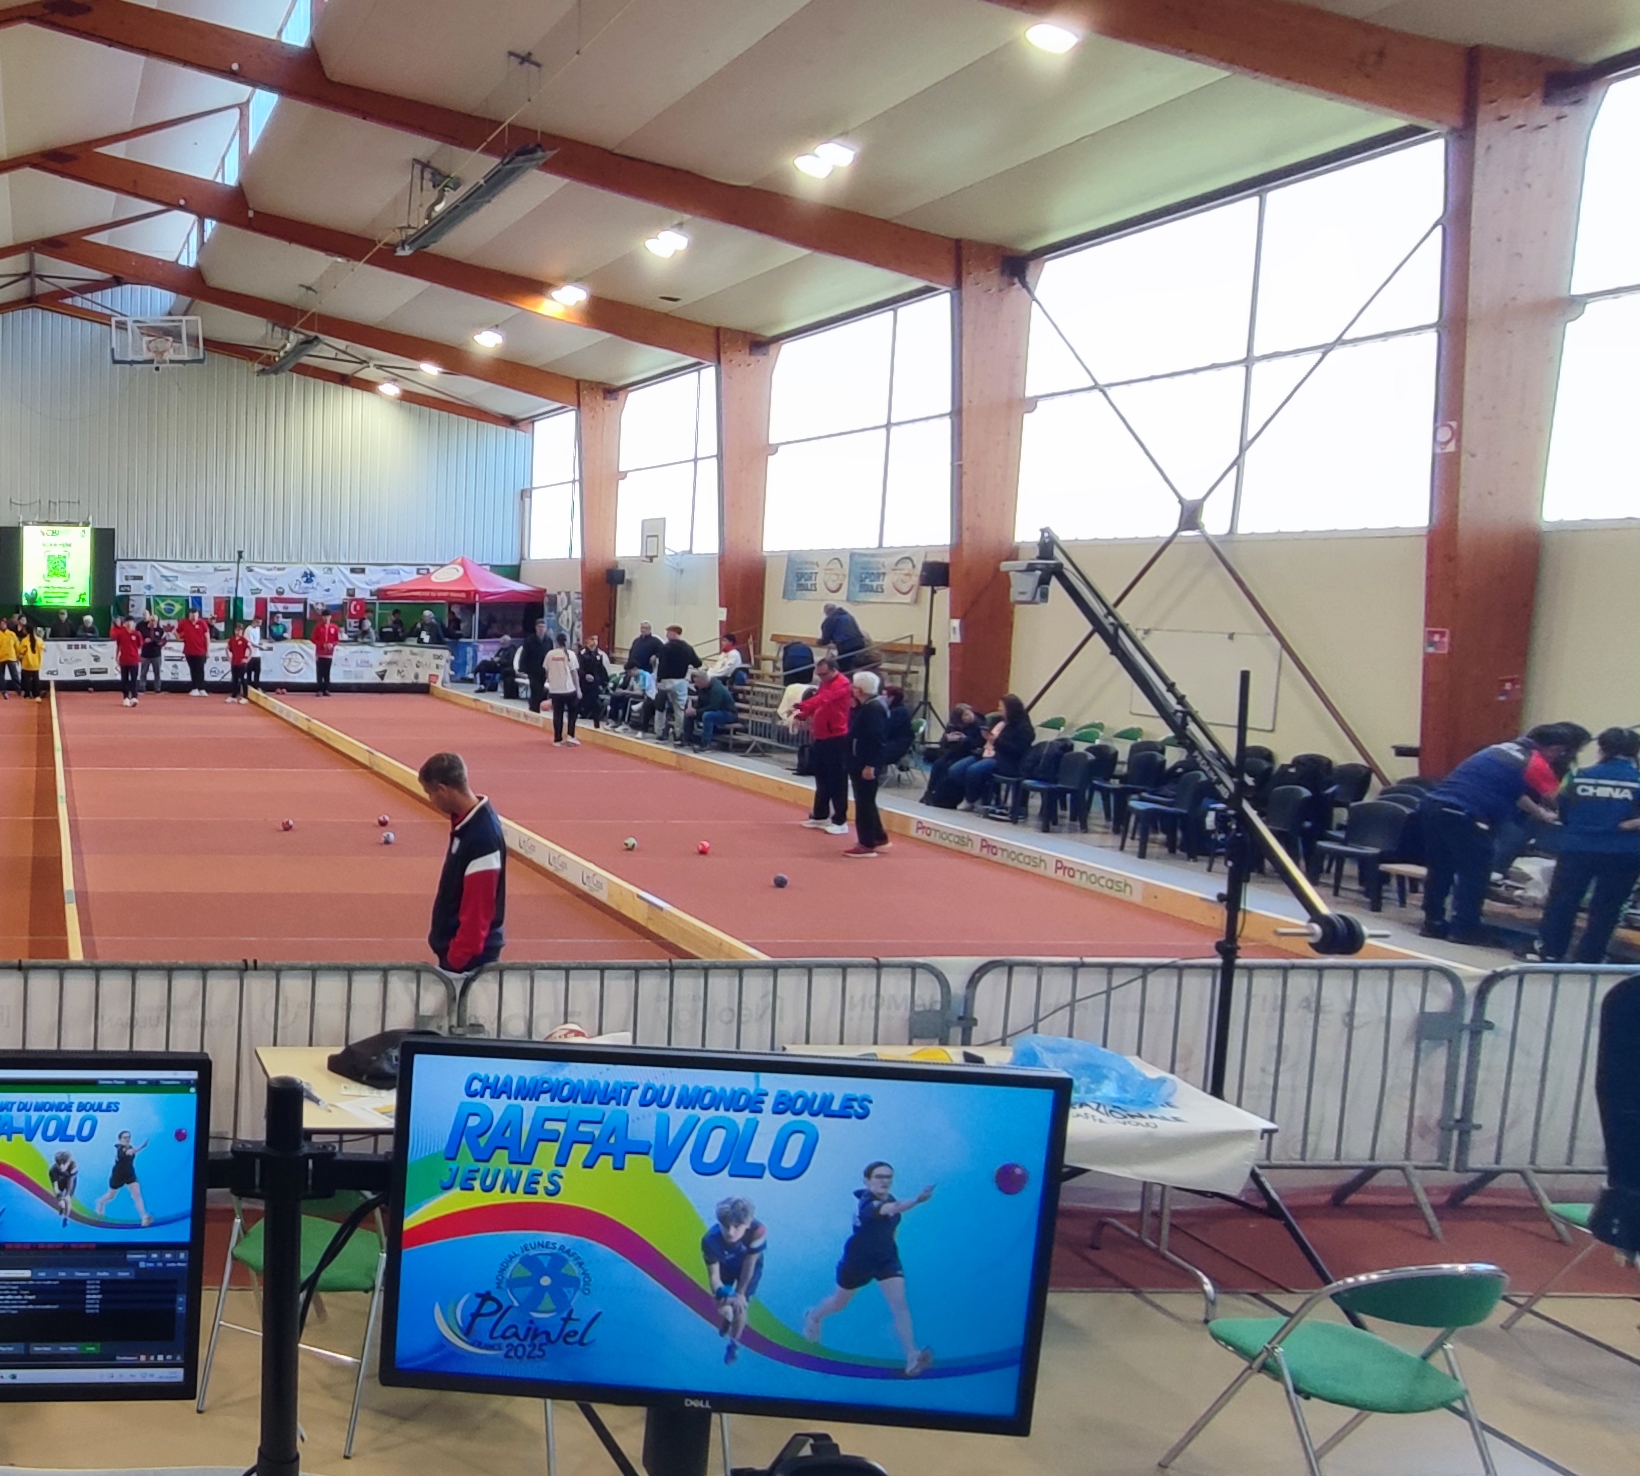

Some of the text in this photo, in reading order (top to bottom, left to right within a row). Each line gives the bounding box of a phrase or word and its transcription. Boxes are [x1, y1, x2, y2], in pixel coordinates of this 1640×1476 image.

[1576, 784, 1634, 801] CHINA
[16, 1101, 33, 1113] DU
[33, 1101, 74, 1113] MONDE
[76, 1101, 121, 1113] BOULES
[465, 1073, 873, 1120] CHAMPIONNAT DU MONDE BOULES
[444, 1101, 820, 1181] RAFFA-VOLO
[439, 1165, 564, 1196] JEUNES
[496, 1240, 592, 1296] MONDIAL JEUNES RAFFA-VOLO
[464, 1290, 603, 1347] Plaintel
[503, 1342, 546, 1360] 2025
[684, 1398, 712, 1409] DELL
